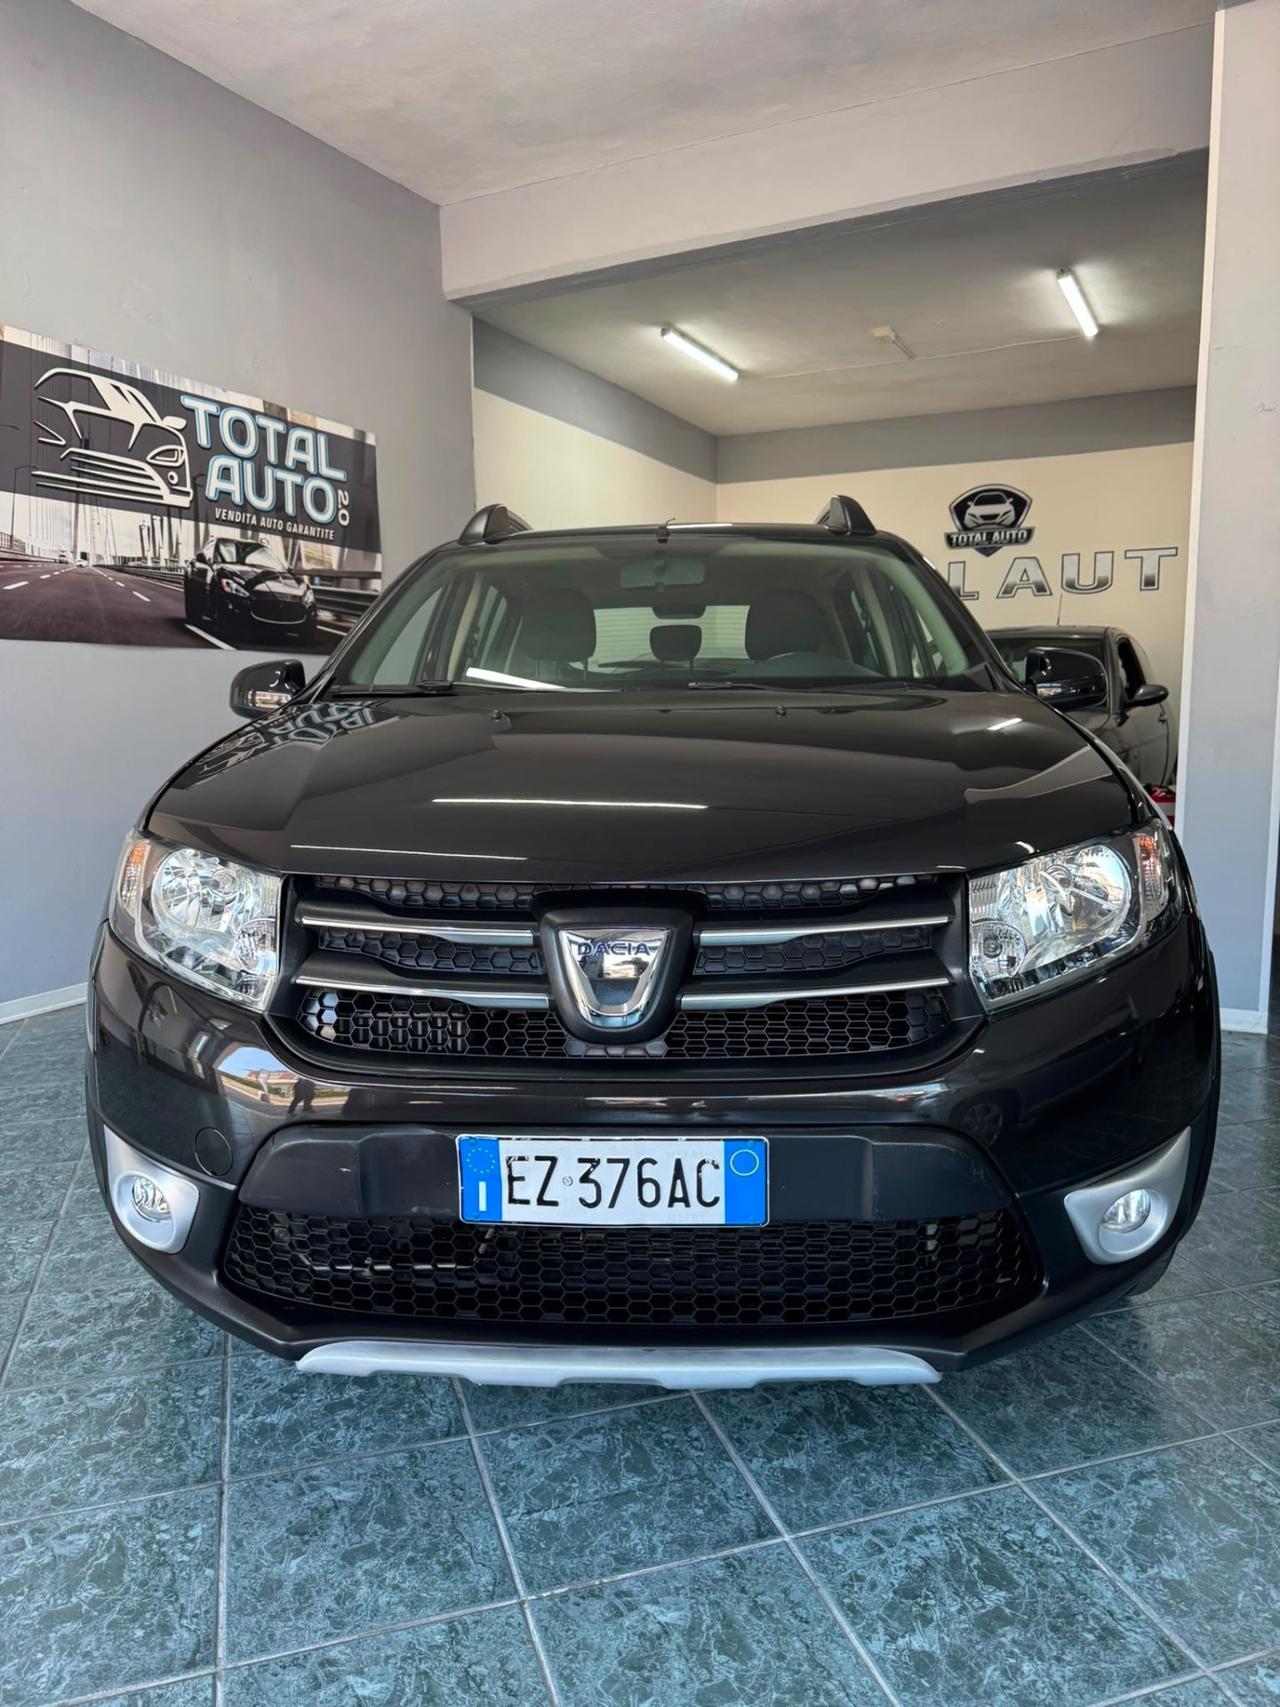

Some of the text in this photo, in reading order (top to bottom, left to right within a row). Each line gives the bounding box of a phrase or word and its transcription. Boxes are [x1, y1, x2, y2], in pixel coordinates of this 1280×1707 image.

[180, 395, 347, 482] TOTAL
[205, 455, 337, 524] AUTO
[214, 507, 336, 541] VENDITA AUTO GARANTITE
[950, 529, 1028, 547] TOTAL AUTO
[577, 941, 651, 956] DACIA
